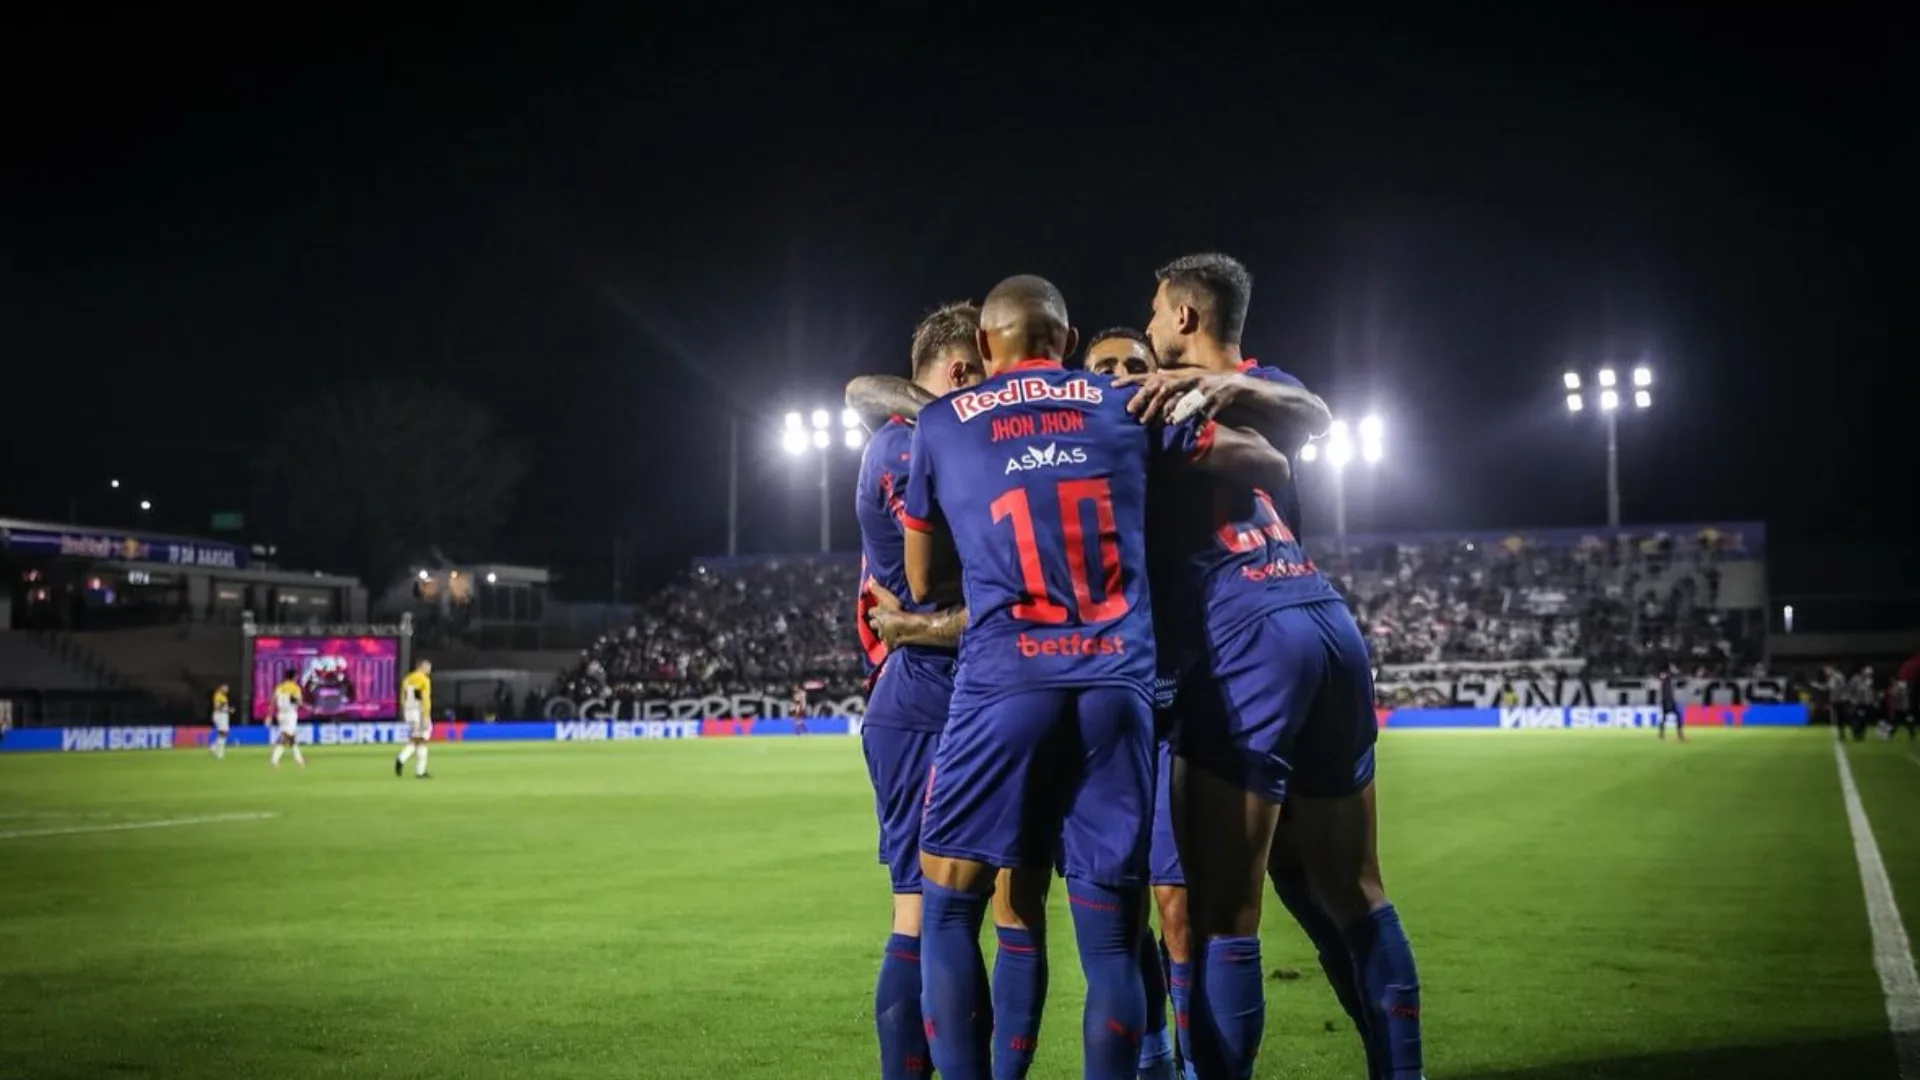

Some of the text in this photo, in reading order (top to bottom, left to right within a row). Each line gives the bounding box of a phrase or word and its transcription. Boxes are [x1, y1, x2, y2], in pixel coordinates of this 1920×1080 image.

[952, 378, 1103, 422] Red Bulls
[991, 411, 1084, 442] JHON JHON
[990, 478, 1129, 624] 10
[1016, 632, 1125, 657] betfast
[555, 721, 605, 739] VIVA
[611, 720, 700, 738] SORTE
[1500, 706, 1566, 728] VIVA
[62, 728, 105, 751] VIVA
[108, 726, 174, 749] SORTE
